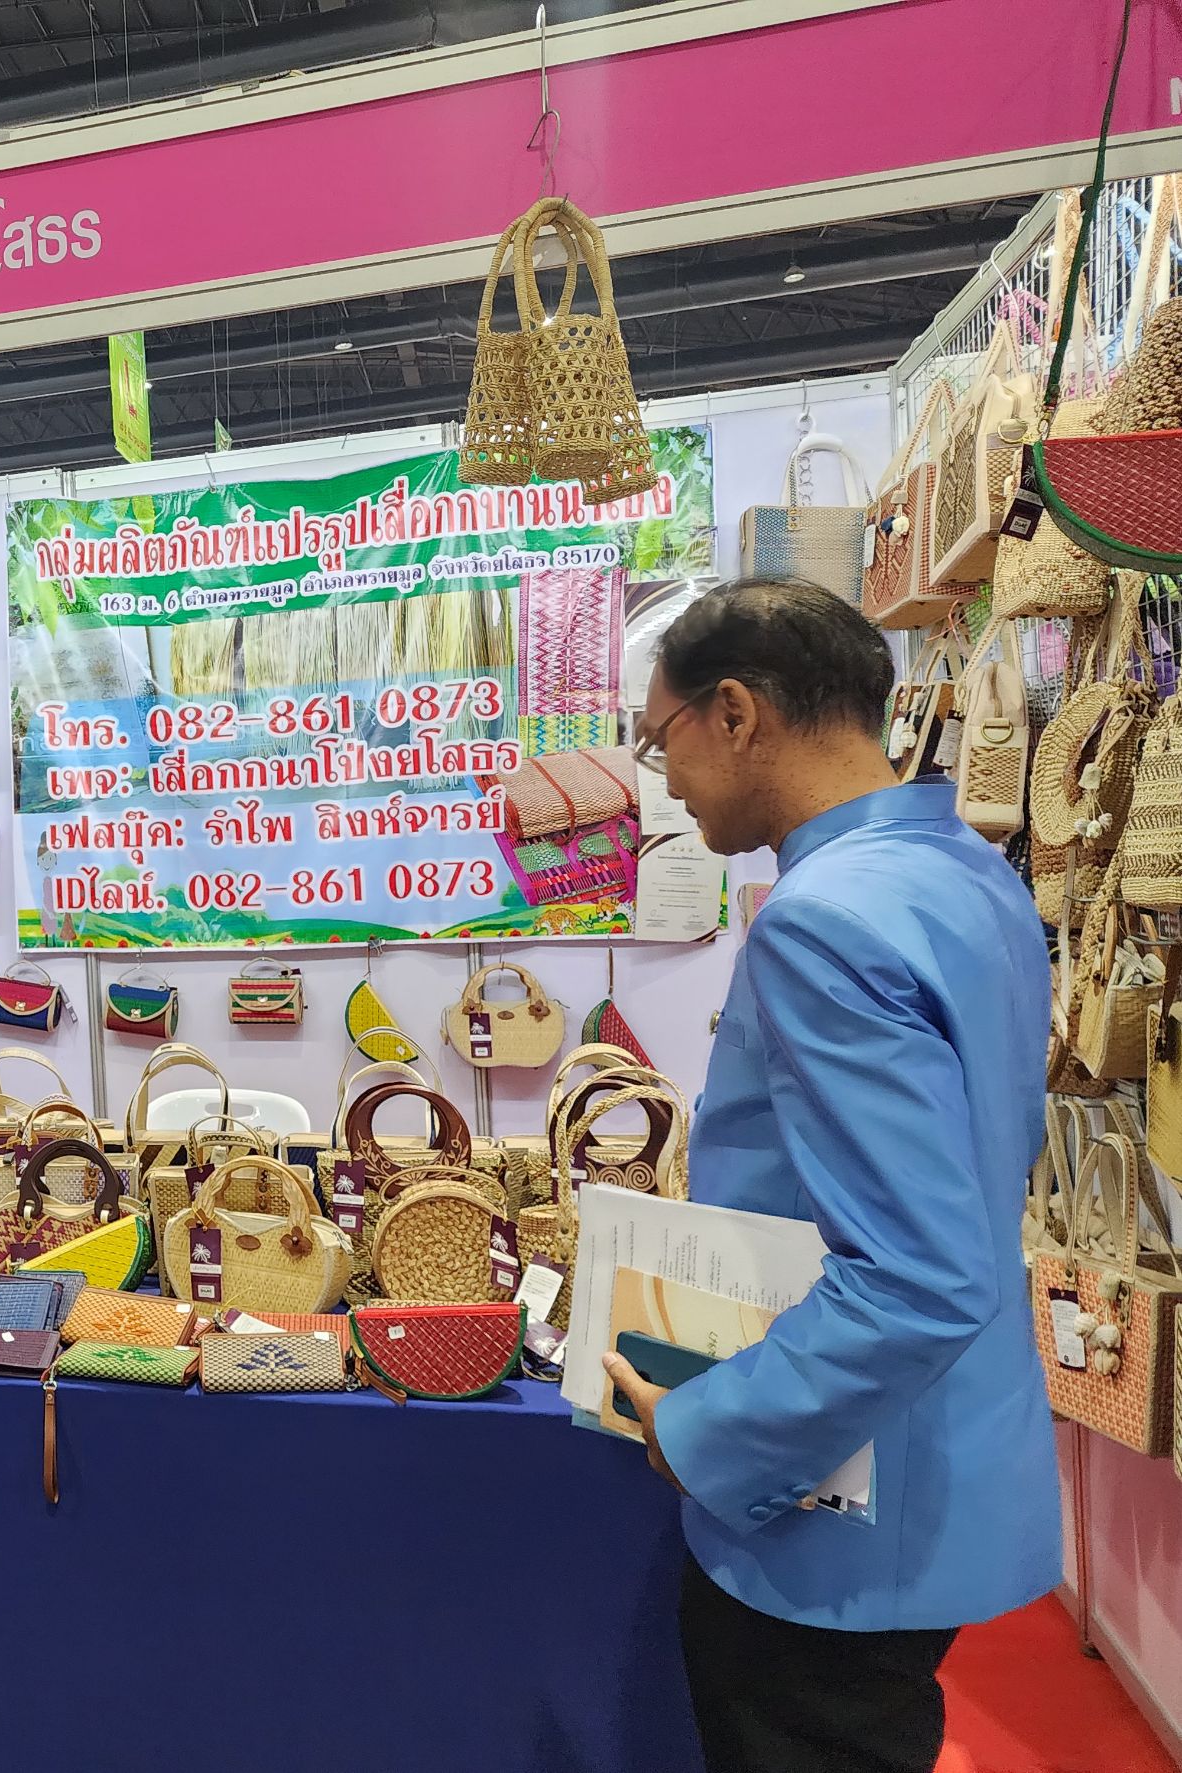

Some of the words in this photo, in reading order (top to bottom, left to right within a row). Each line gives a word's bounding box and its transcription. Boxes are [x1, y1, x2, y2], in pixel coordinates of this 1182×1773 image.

[103, 596, 132, 611] 163
[141, 599, 158, 611] ม.
[167, 594, 176, 609] 6
[185, 582, 293, 606] ตำบลทรายมูล
[303, 567, 423, 593] อำเภอทรายมูล
[431, 549, 546, 576] จังหวัดยโสธร
[556, 547, 615, 566] 35170
[40, 704, 128, 747] โทร.
[149, 694, 354, 743] 082-861
[379, 680, 500, 724] 0873
[49, 766, 130, 796] เพจ:
[151, 728, 519, 793] เสื่อกกนาโป่งยโสธร
[49, 810, 184, 865] เฟสบุ๊ค:
[205, 799, 293, 846] รำไพ
[315, 788, 503, 840] สิงห์จารย์
[55, 866, 165, 909] IDไลน์.
[188, 867, 363, 909] 082-861
[388, 860, 494, 899] 0873
